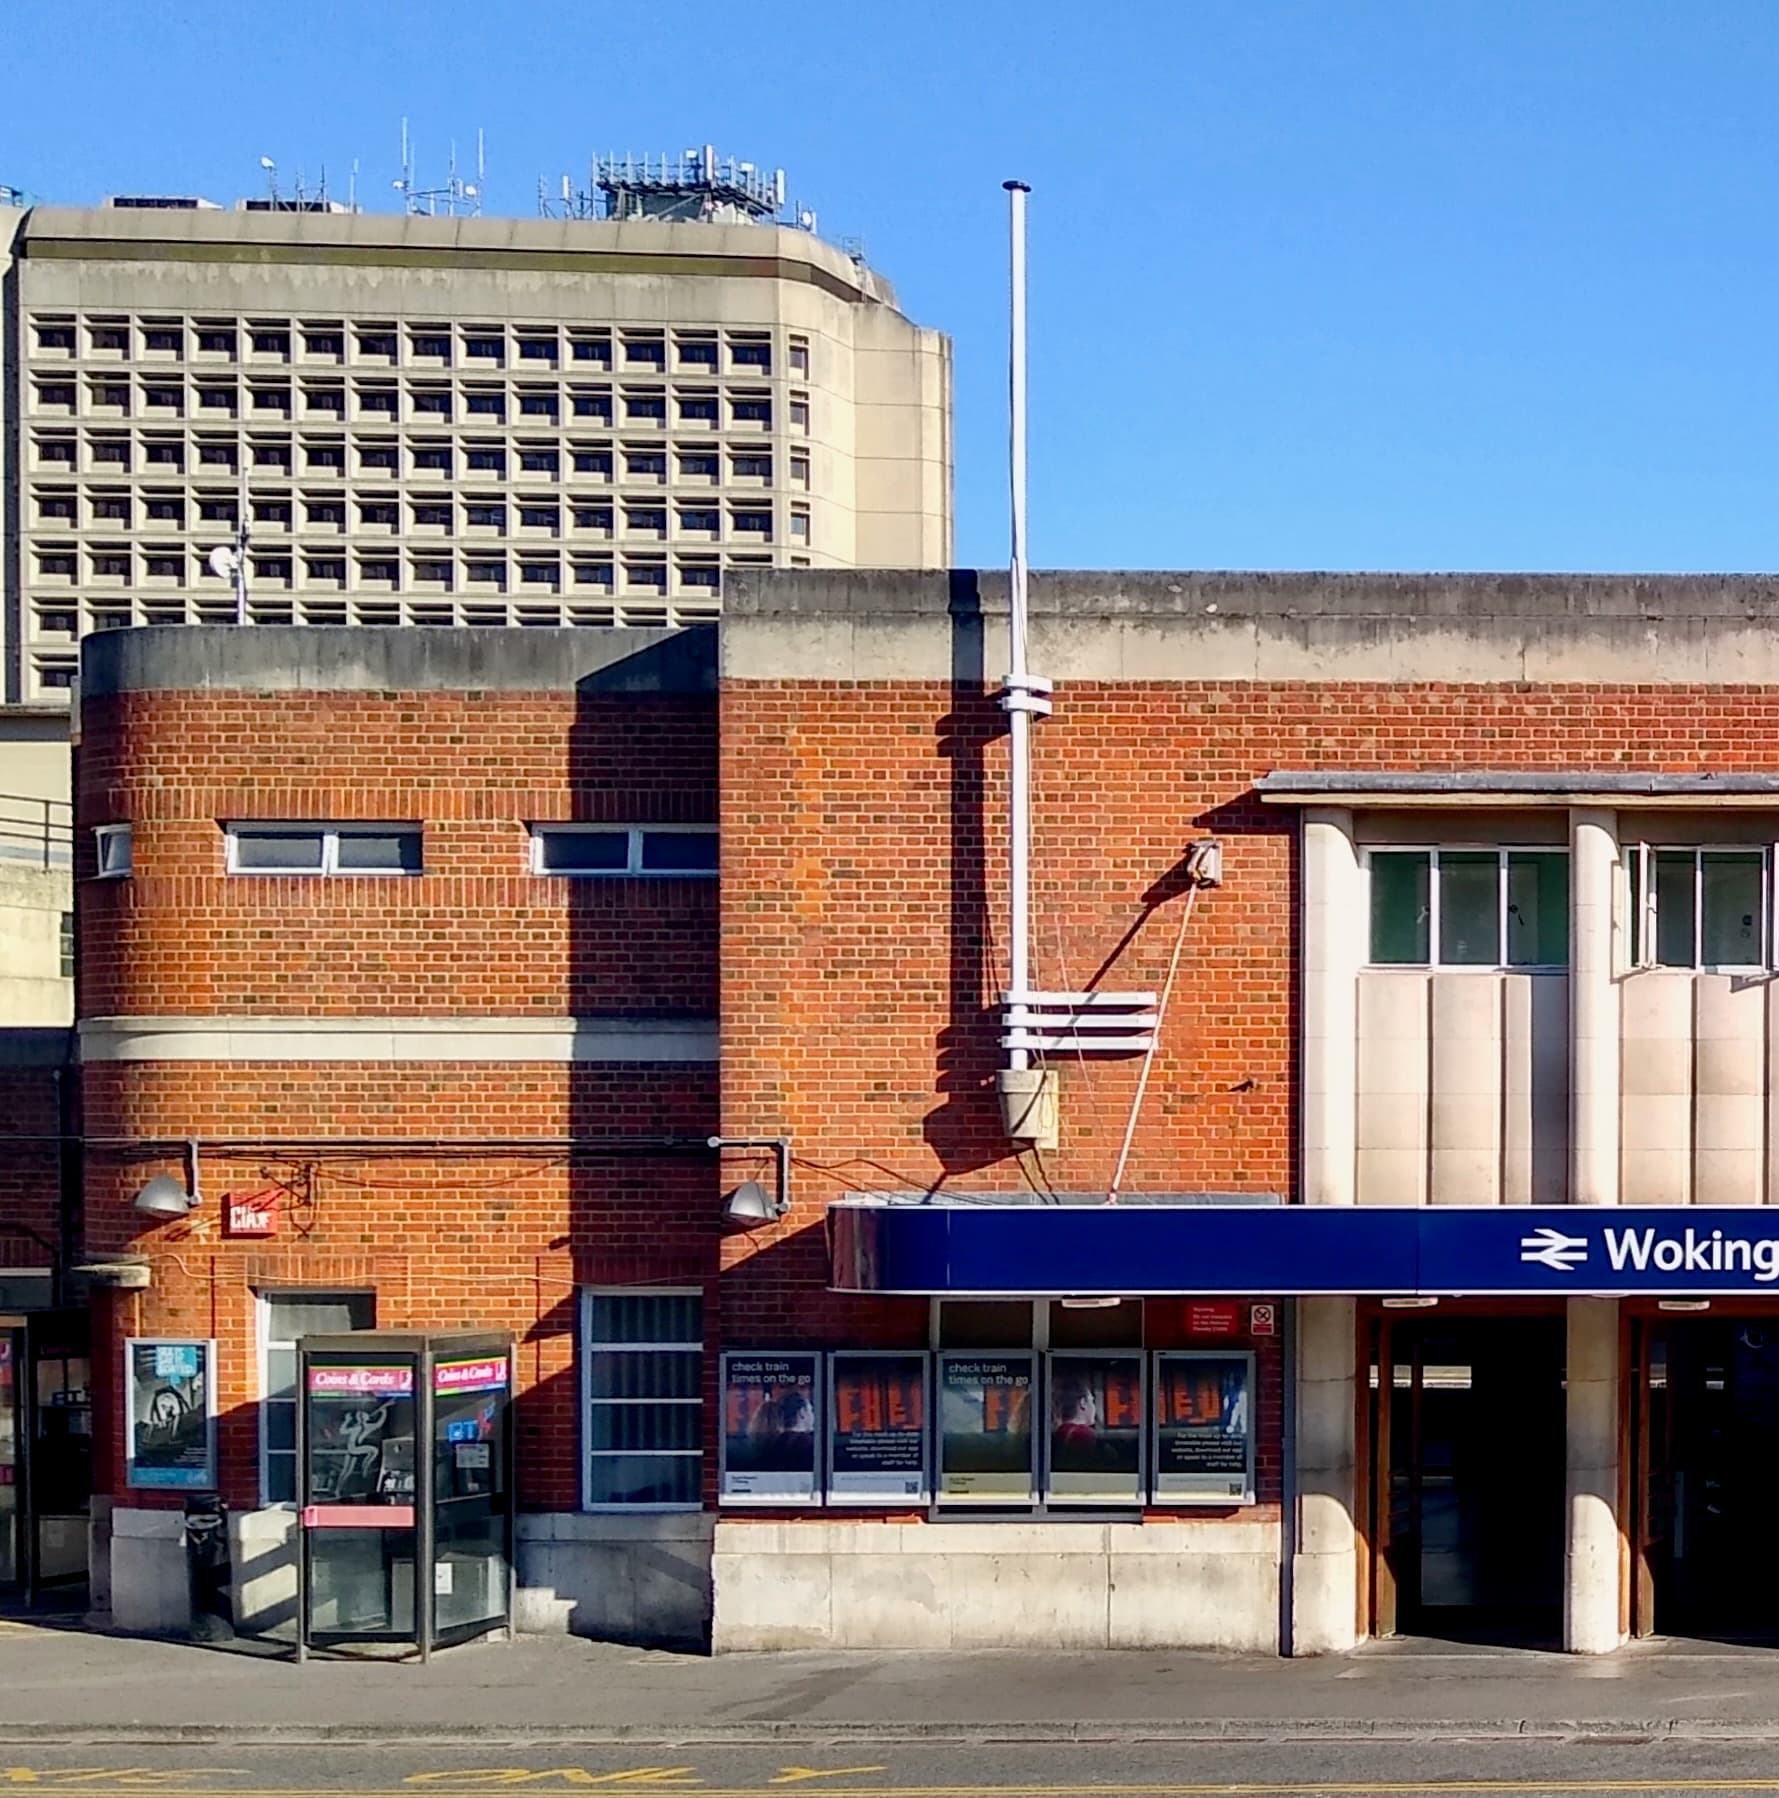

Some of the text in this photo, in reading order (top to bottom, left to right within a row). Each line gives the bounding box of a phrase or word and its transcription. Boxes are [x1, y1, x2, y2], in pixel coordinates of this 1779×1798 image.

[732, 1361, 789, 1371] check train
[949, 1362, 1007, 1373] check train
[315, 1371, 395, 1385] Coins & Cards
[731, 1374, 811, 1386] times on the go
[948, 1374, 1029, 1387] times on the go
